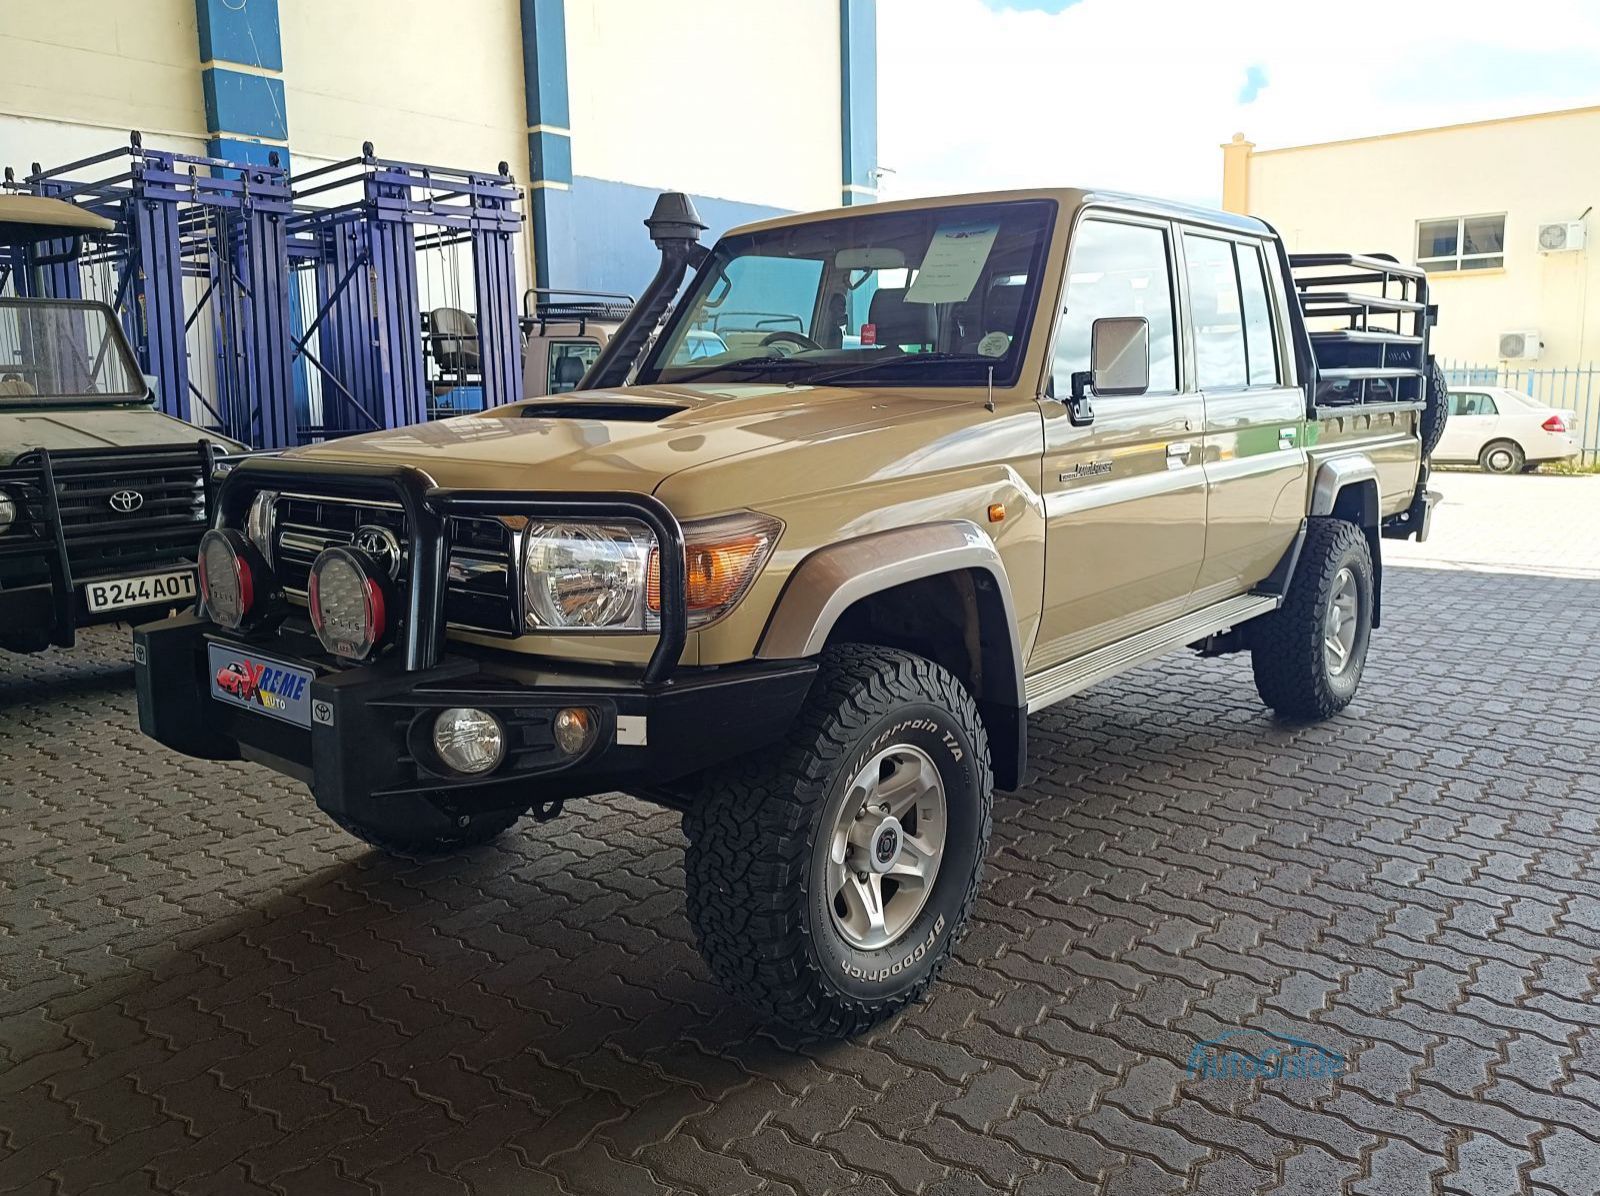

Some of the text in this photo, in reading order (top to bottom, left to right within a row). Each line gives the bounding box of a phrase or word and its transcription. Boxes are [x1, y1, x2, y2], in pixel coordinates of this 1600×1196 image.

[266, 695, 286, 710] AUTO
[942, 730, 963, 762] T/A
[841, 913, 945, 983] BFGoodrich
